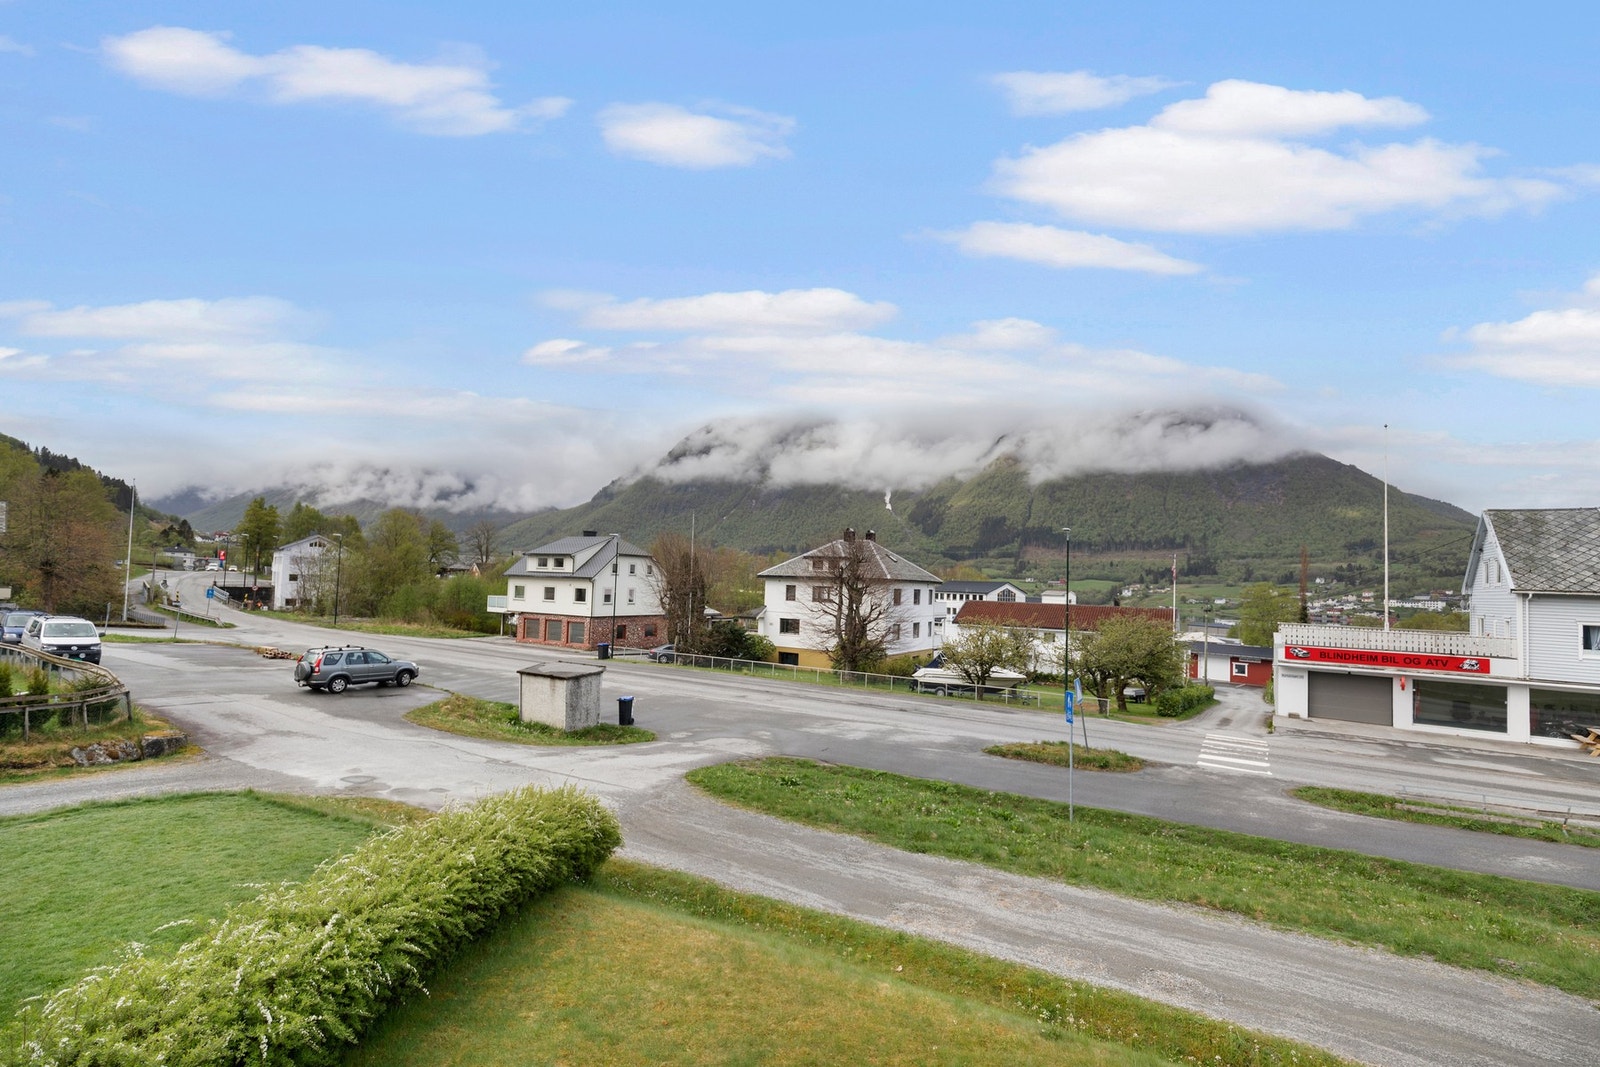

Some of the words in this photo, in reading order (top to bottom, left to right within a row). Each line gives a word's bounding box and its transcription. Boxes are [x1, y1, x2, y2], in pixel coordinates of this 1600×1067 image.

[1320, 651, 1378, 662] BLINDHEIM
[1381, 655, 1399, 664] BIL
[1403, 657, 1421, 665] OG
[1425, 658, 1448, 667] ATV
